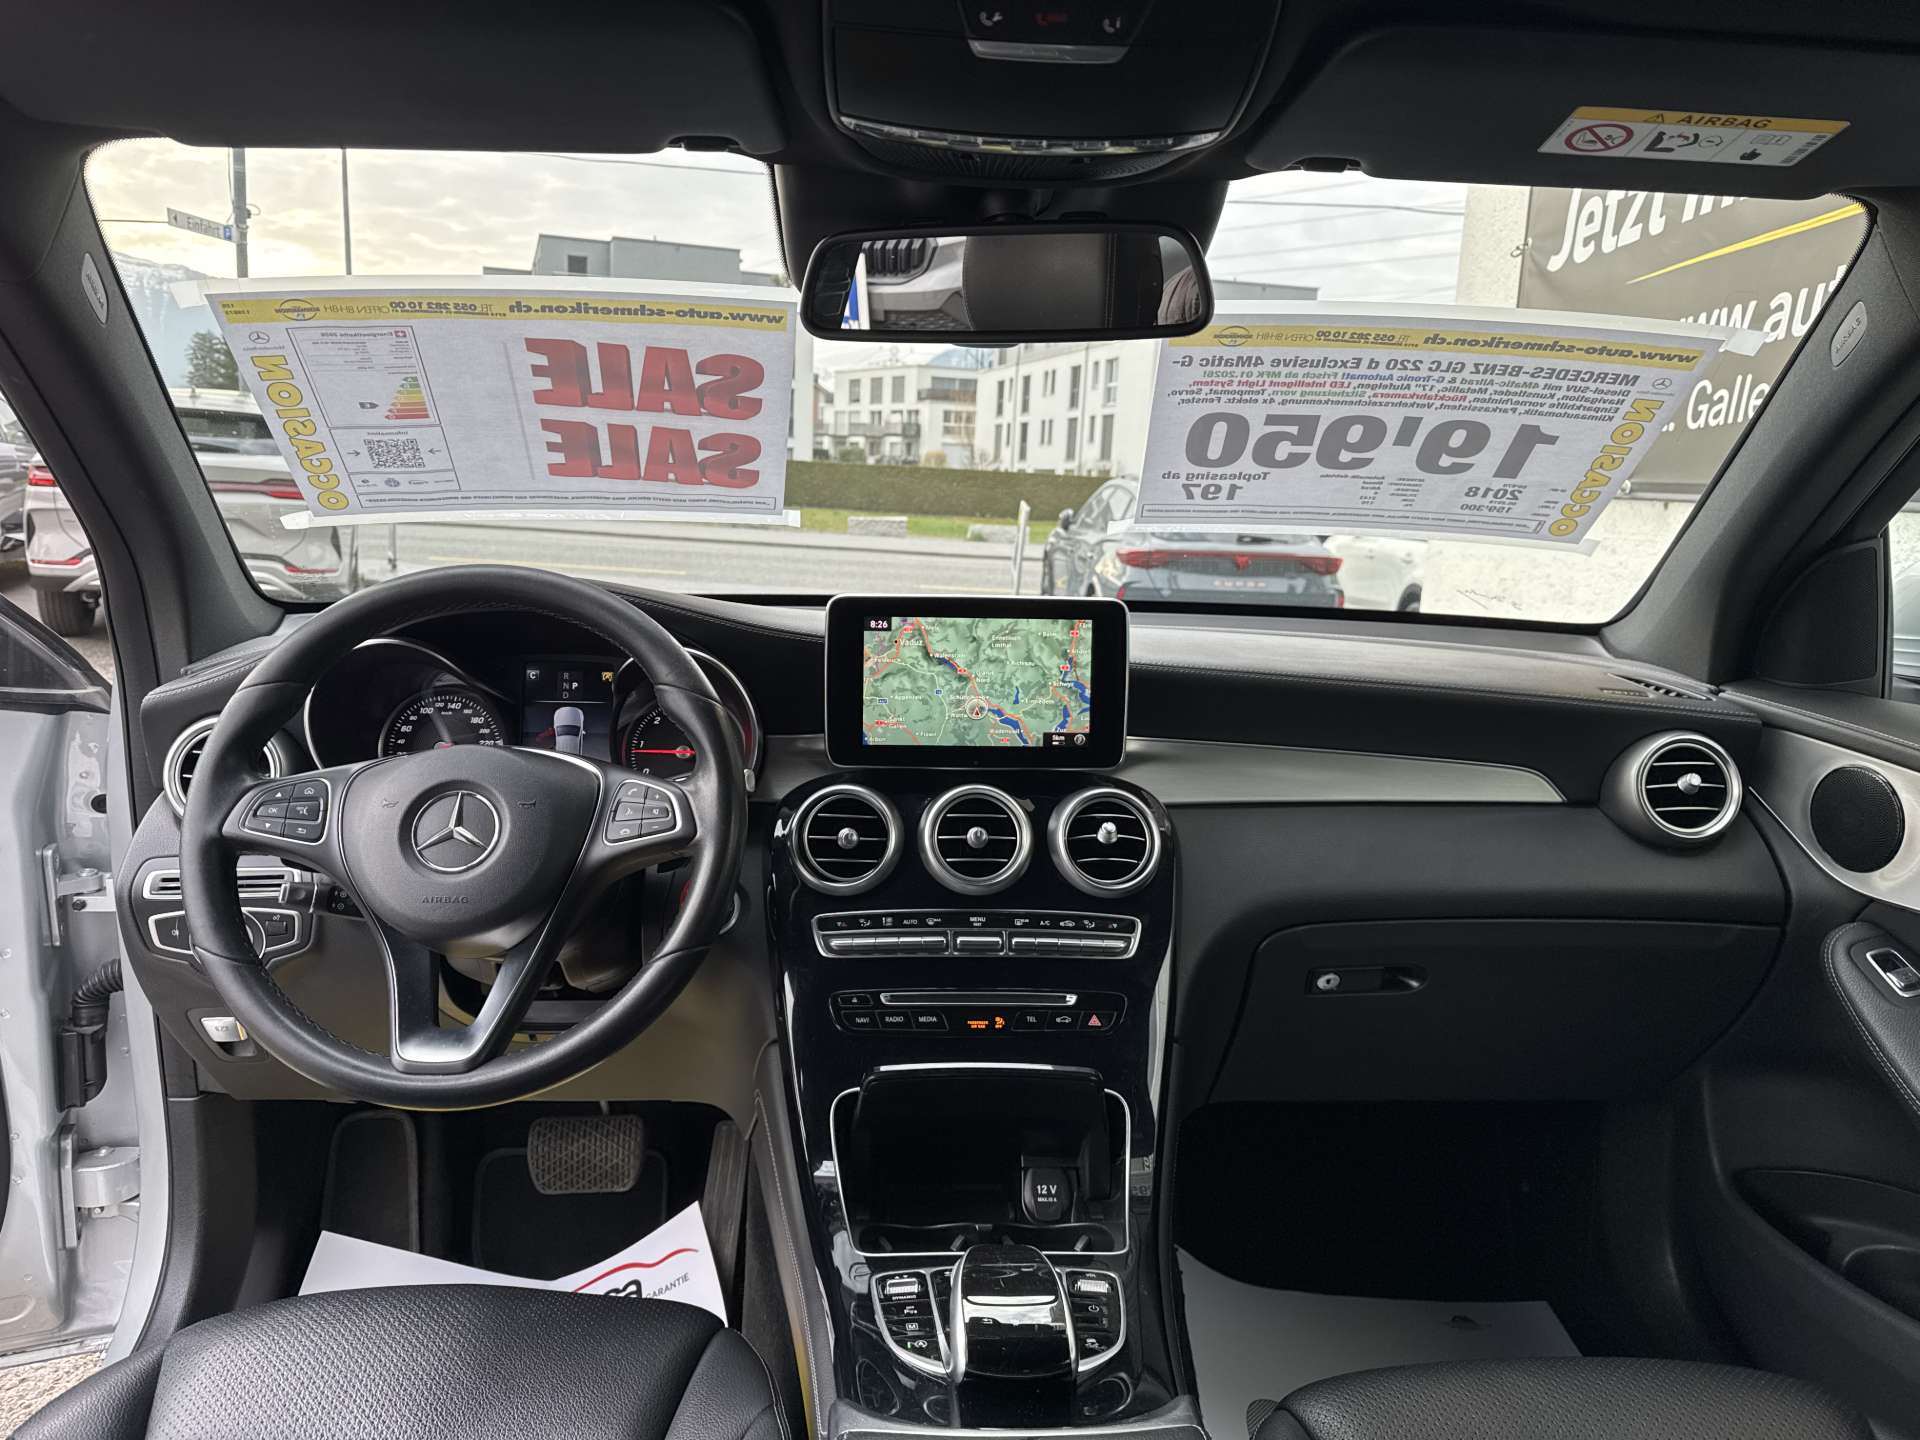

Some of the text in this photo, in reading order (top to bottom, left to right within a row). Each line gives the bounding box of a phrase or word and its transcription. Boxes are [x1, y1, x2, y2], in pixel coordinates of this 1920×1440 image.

[1676, 113, 1772, 129] AIRBAG
[186, 216, 221, 238] Einfahrt
[1546, 187, 1666, 272] Jetzt
[870, 620, 888, 628] 8:26
[529, 671, 537, 679] C
[563, 682, 569, 690] N
[563, 691, 569, 699] D
[447, 702, 462, 710] 140
[653, 717, 661, 725] 2
[422, 896, 469, 904] AIRBAG
[1037, 1185, 1057, 1194] 12 V
